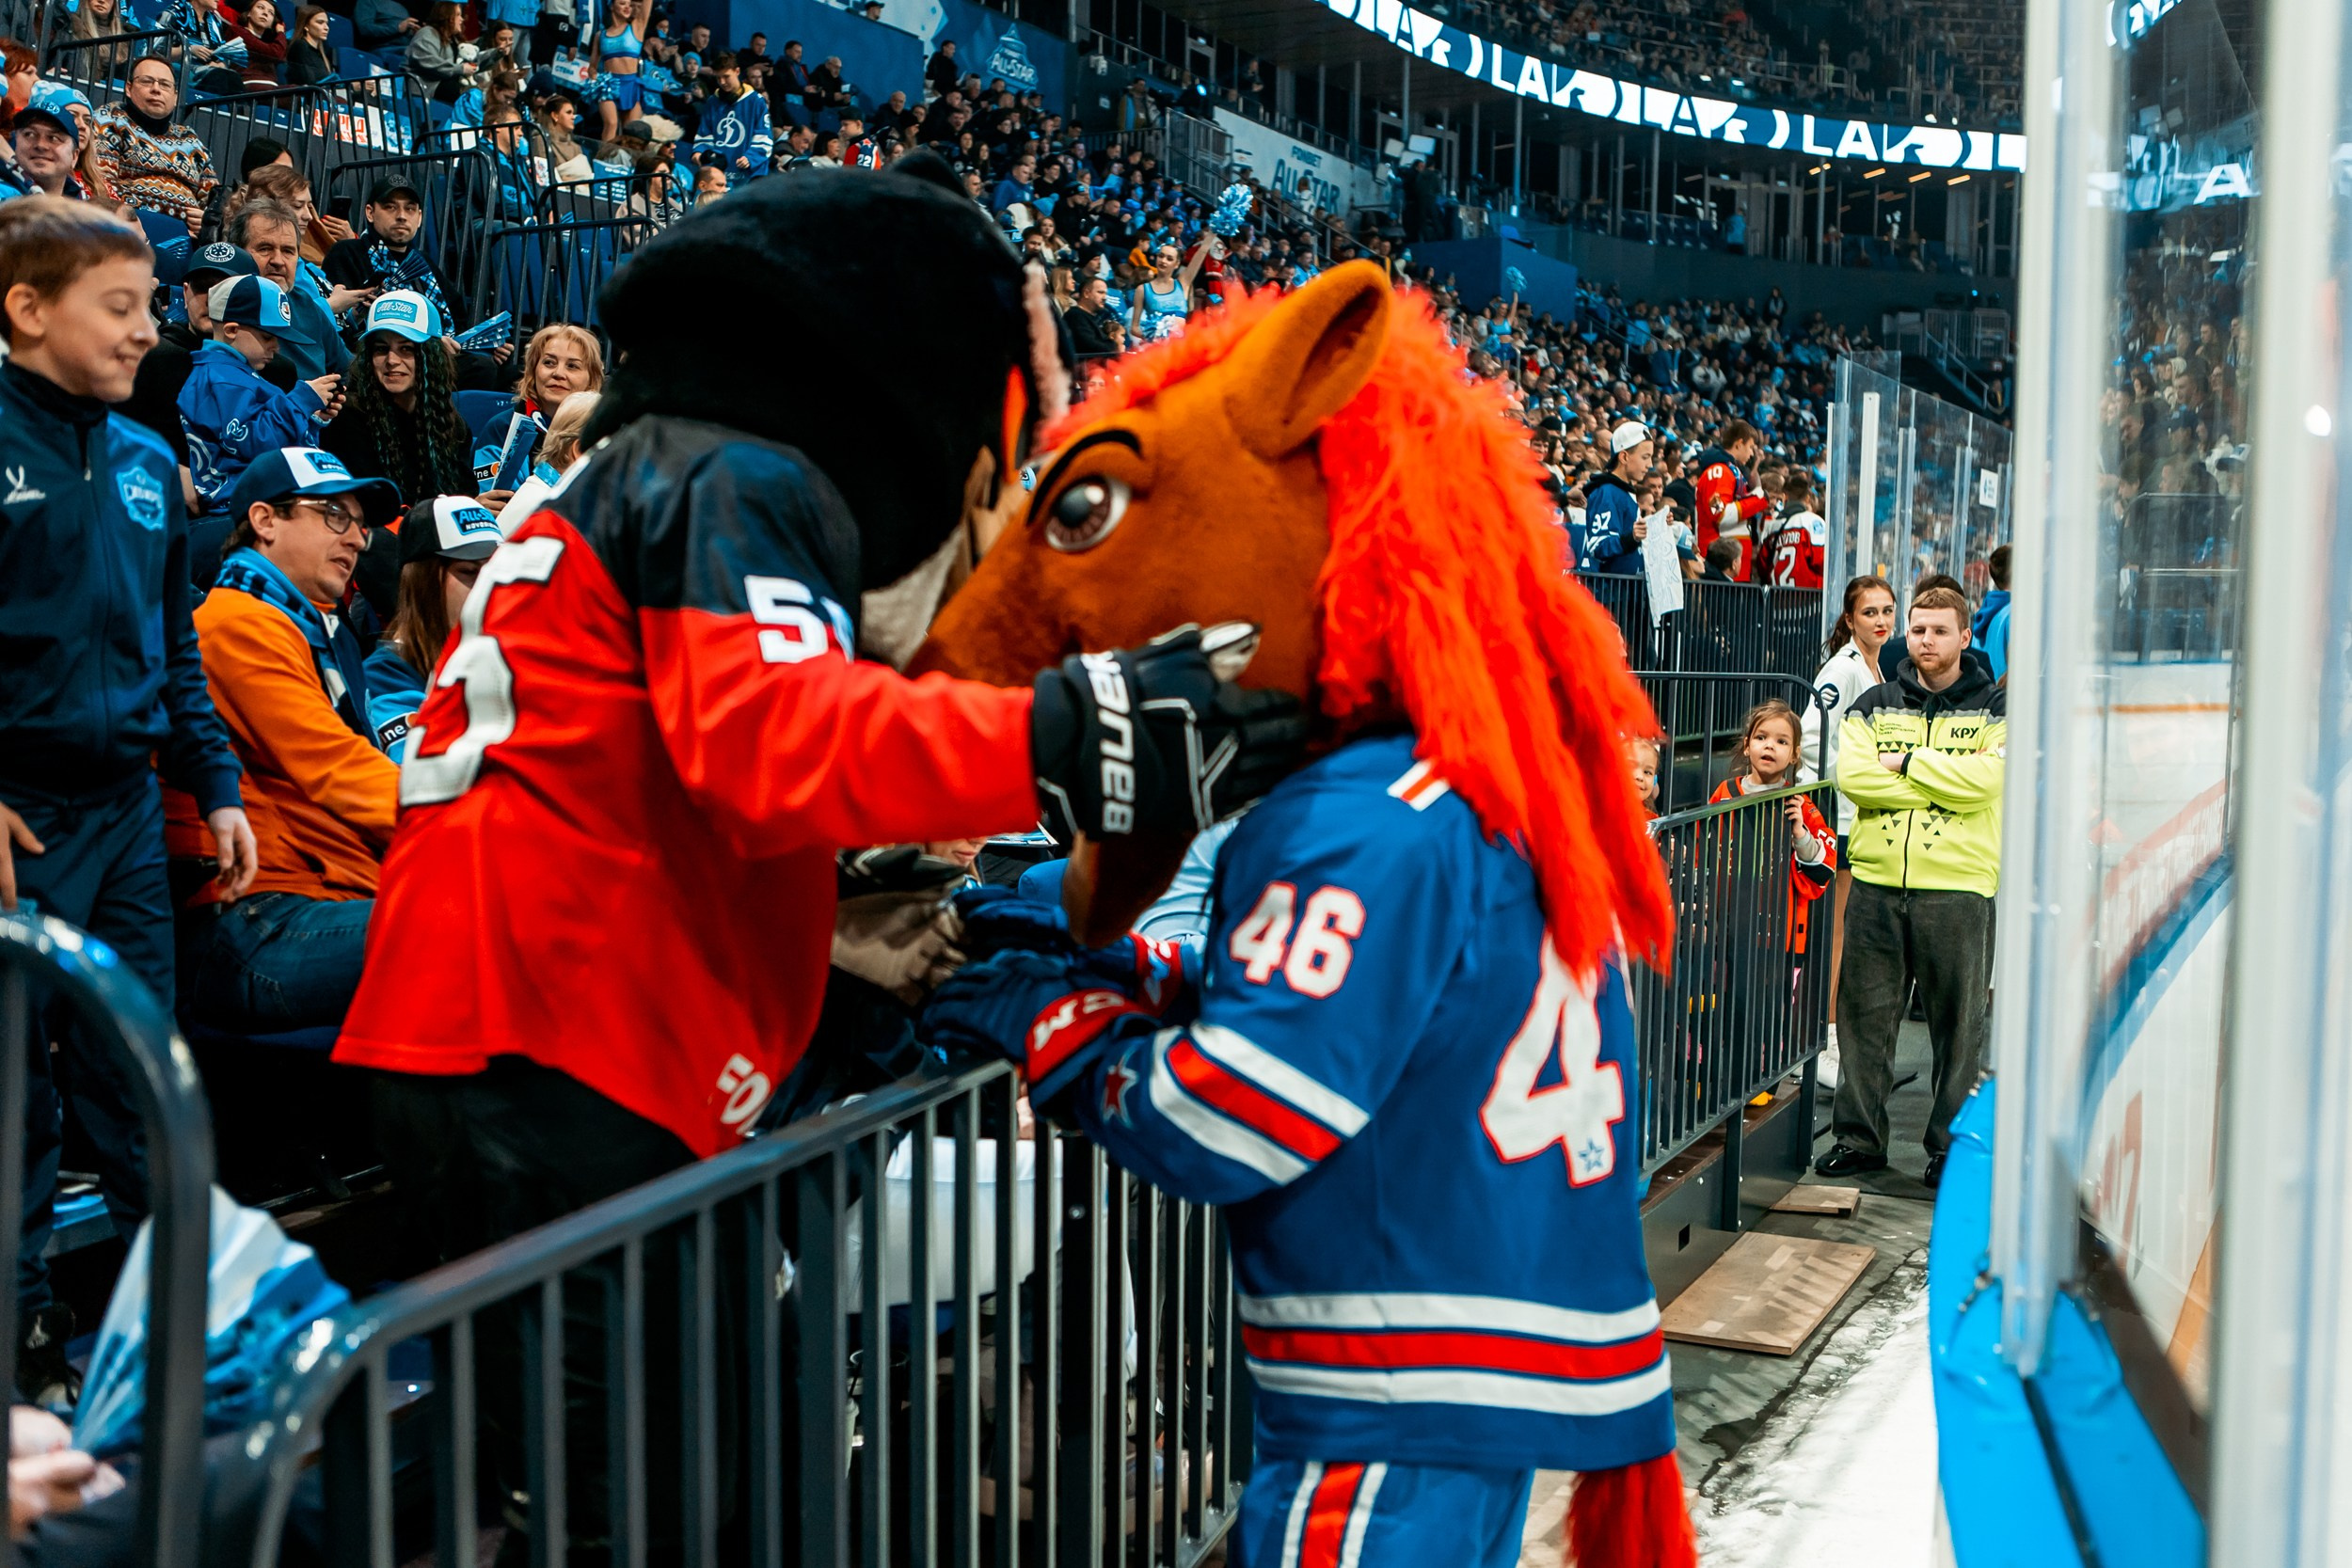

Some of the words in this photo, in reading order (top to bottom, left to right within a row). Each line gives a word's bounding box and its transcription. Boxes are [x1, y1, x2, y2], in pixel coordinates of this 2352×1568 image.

[1708, 465, 1723, 481] 10
[1591, 511, 1612, 534] 37
[1229, 879, 1367, 1001] 46
